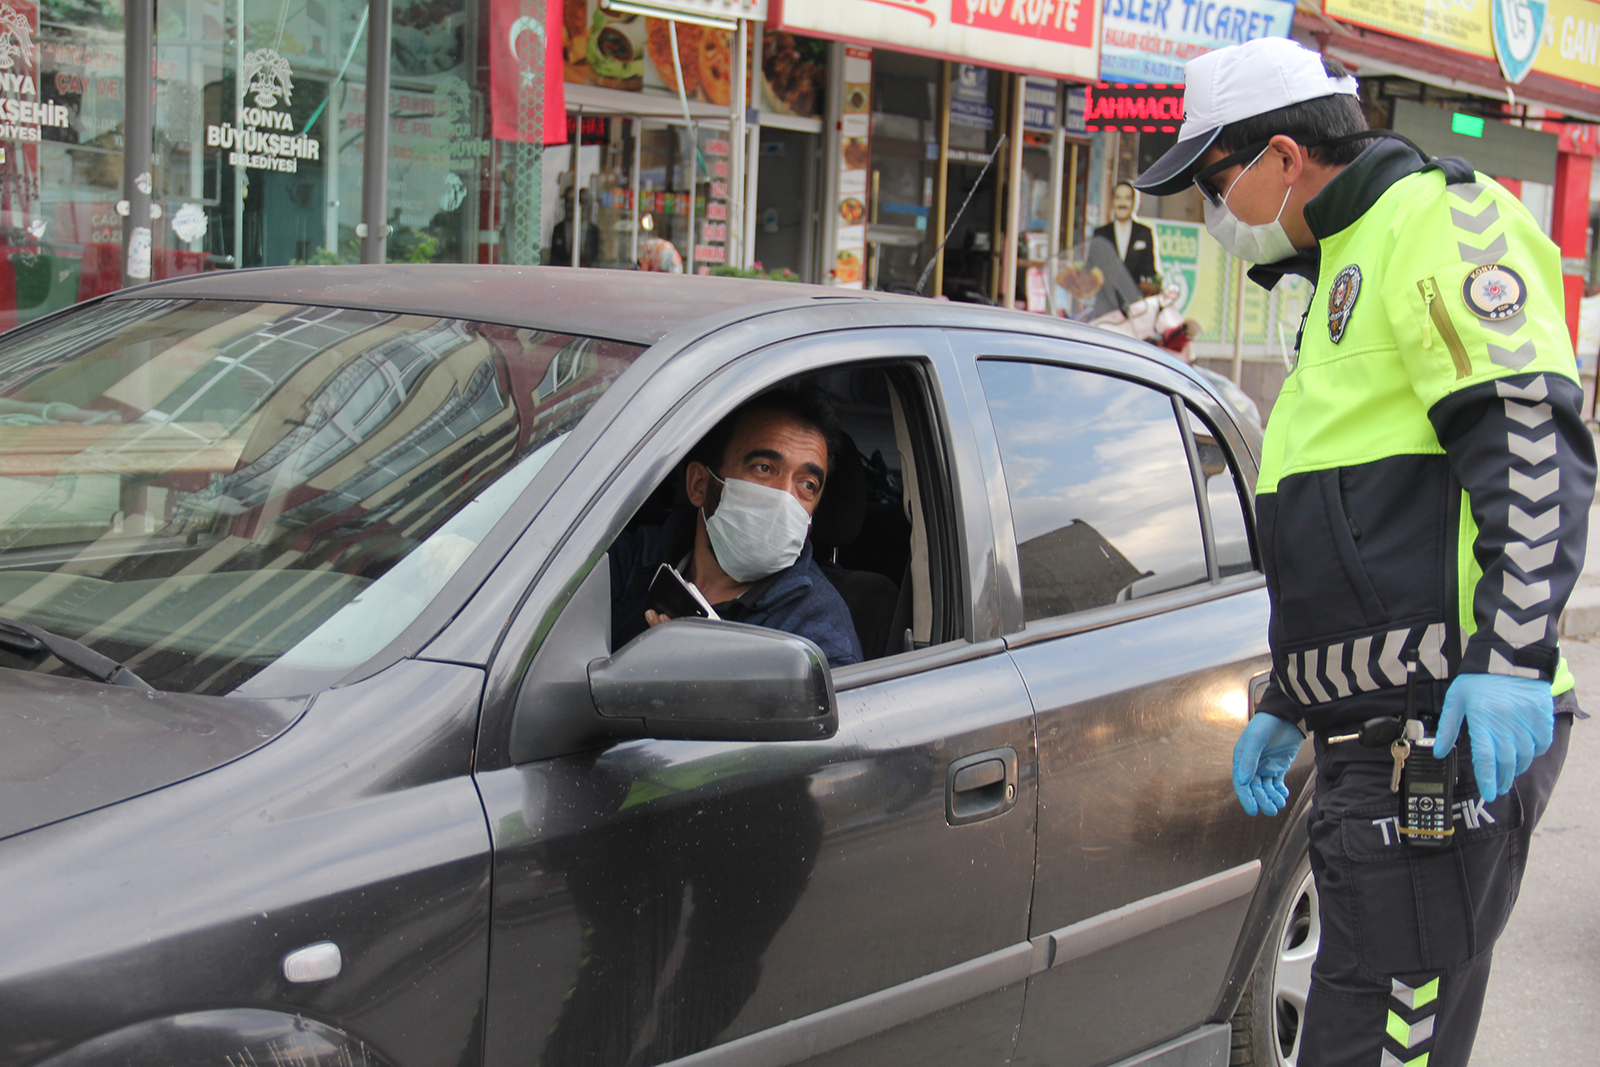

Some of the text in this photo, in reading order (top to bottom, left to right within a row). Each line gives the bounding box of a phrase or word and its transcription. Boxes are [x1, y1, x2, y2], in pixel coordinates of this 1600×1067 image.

[55, 72, 119, 98] ÇAY VE
[238, 106, 294, 131] KONYA
[207, 121, 320, 161] BÜYÜKŞEHİR
[229, 151, 297, 174] BELEDİYESİ
[1471, 264, 1499, 280] KONYA
[1372, 796, 1496, 846] TFİK
